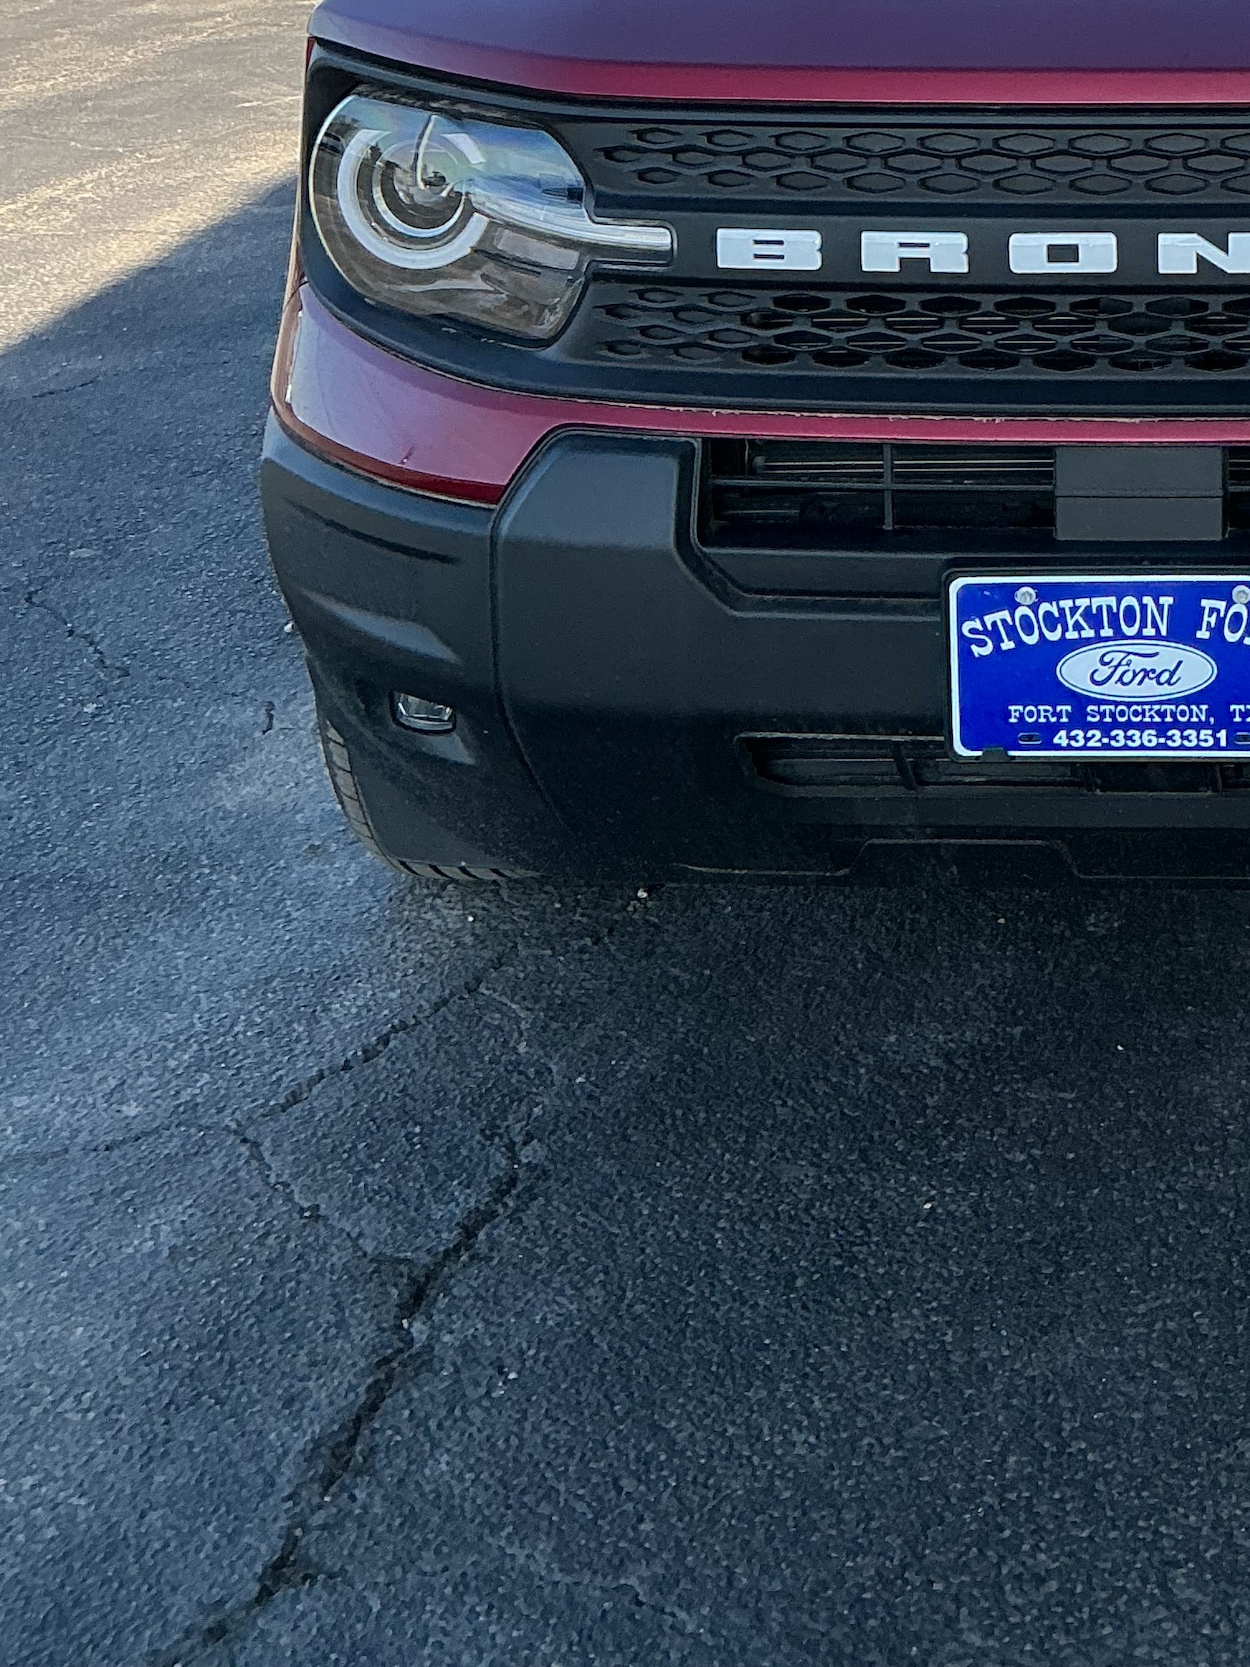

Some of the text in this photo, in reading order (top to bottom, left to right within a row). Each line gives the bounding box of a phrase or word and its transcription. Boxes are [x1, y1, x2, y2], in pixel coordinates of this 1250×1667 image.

[961, 595, 1174, 658] STOCKTON
[1089, 649, 1183, 688] Ford
[1008, 705, 1072, 723] FORT
[1086, 705, 1216, 725] STOCKTON,
[1053, 729, 1228, 748] 432-336-3351
